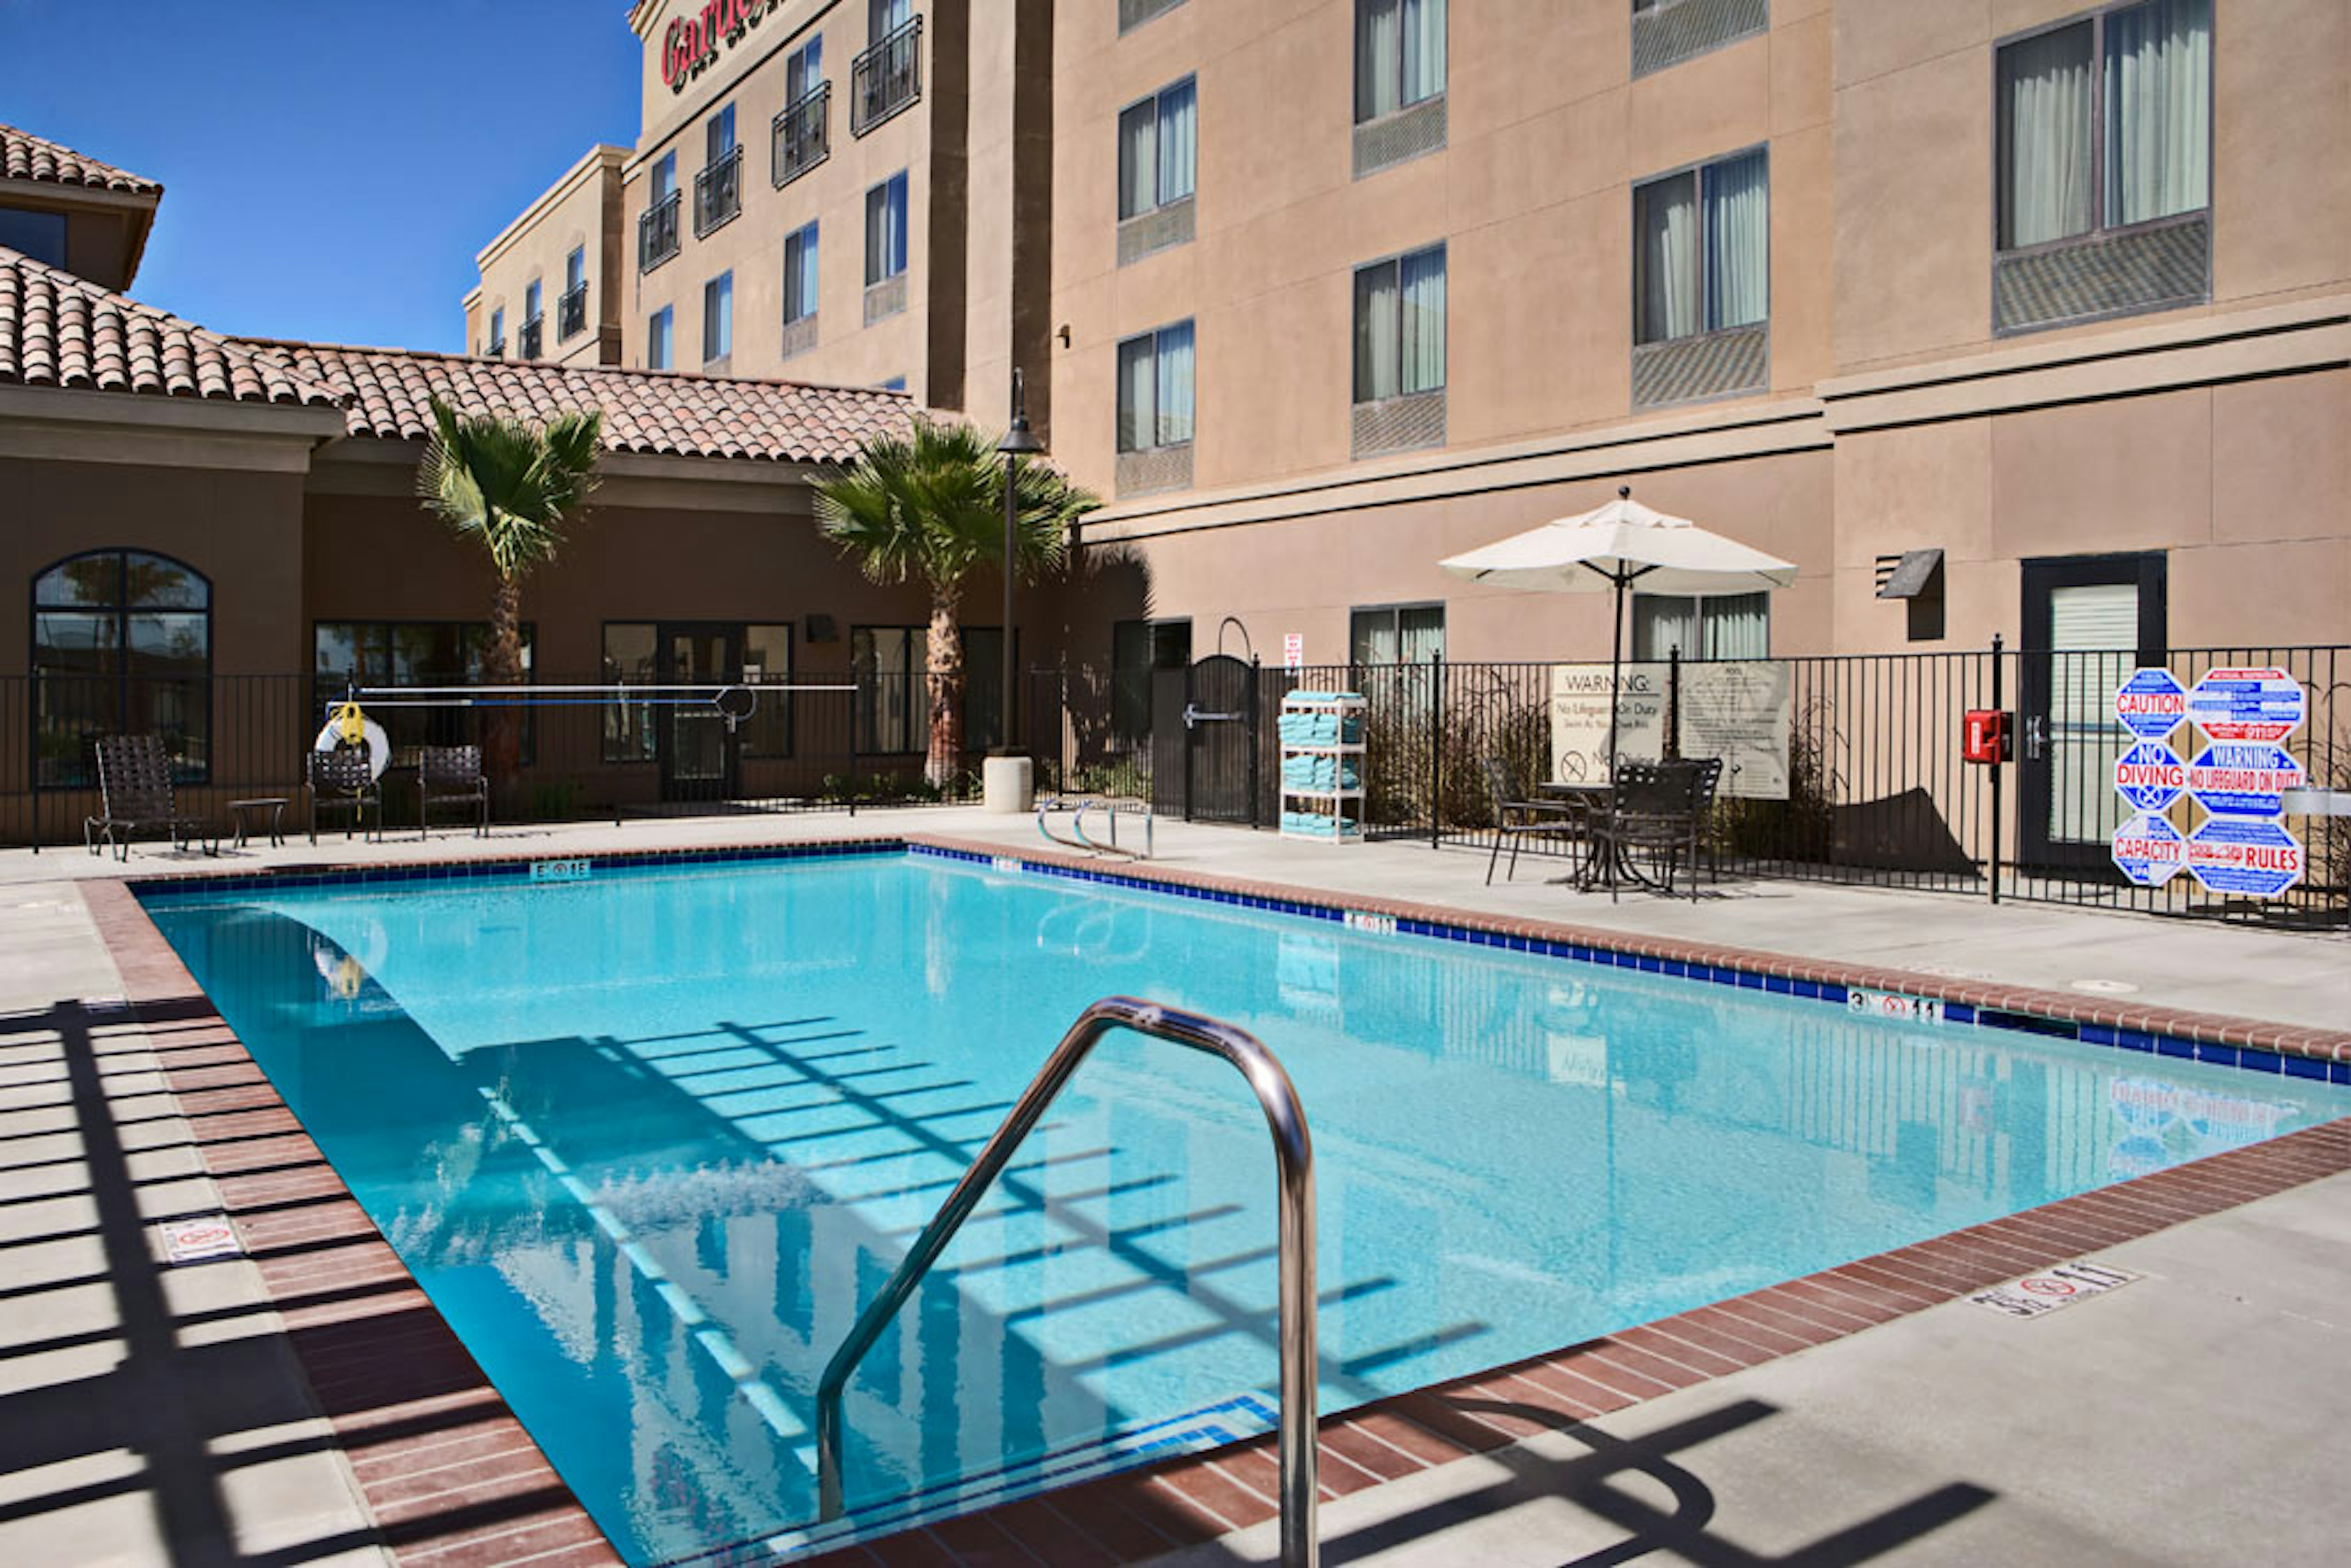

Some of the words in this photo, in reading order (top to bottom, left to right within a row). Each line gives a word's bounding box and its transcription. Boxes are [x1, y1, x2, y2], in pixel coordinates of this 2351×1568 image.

[662, 0, 761, 87] Gard
[1566, 675, 1651, 692] WARNNG:
[1635, 703, 1657, 716] Duty
[2116, 694, 2184, 713] CAUTION
[2139, 744, 2166, 764] NO
[2213, 745, 2279, 768] WARNING
[2117, 765, 2184, 786] DIVING
[2191, 769, 2204, 788] NO
[2206, 770, 2255, 791] LIFEGUARD
[2259, 771, 2273, 791] ON
[2115, 837, 2181, 861] CAPACITY
[2245, 847, 2297, 870] RULES
